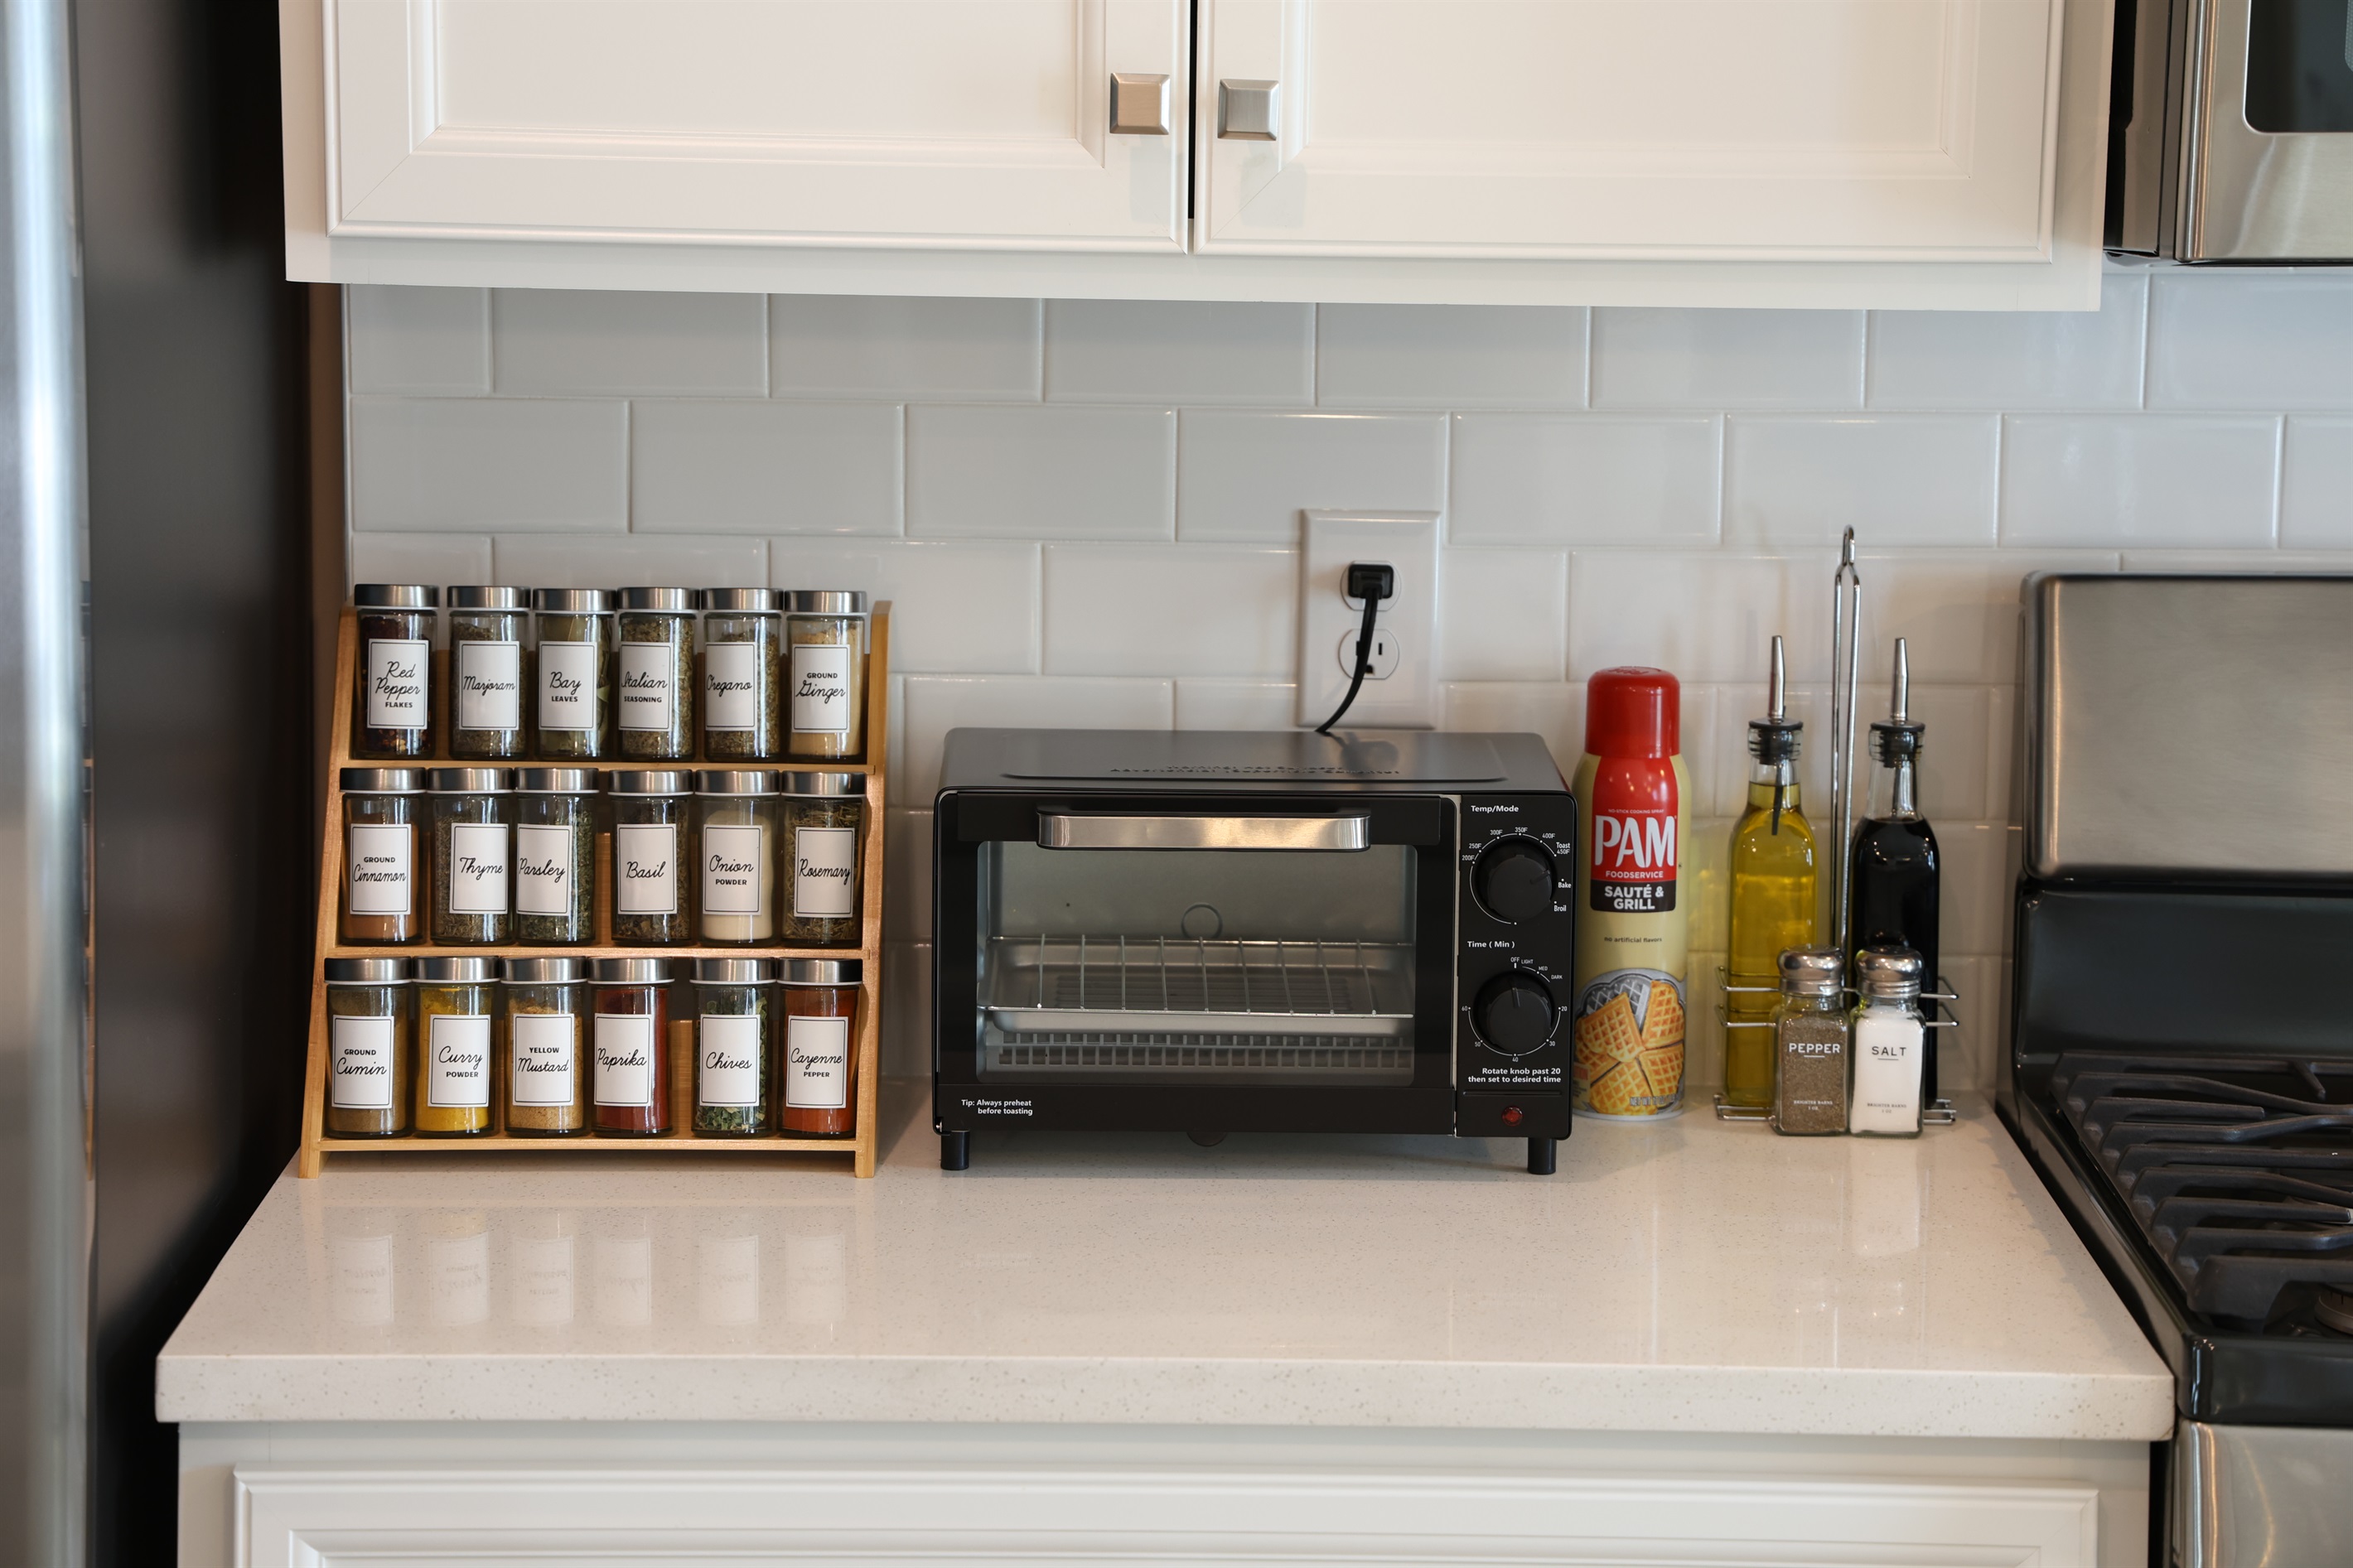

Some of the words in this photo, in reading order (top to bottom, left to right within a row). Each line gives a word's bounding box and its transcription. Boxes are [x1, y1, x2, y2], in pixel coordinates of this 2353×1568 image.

[386, 661, 416, 678] Red
[375, 677, 421, 701] Pepper
[463, 676, 515, 696] Marjoram
[549, 672, 582, 695] Bay
[621, 672, 668, 688] Italian
[707, 674, 752, 697] Oregano
[795, 680, 846, 703] Ginger
[1471, 805, 1520, 813] Temp/Mode
[1594, 815, 1675, 868] PAM
[460, 857, 504, 880] Thyme
[519, 857, 566, 883] Parsley
[626, 861, 666, 879] Basil
[709, 855, 754, 872] Onion
[799, 858, 850, 885] Rosemary
[354, 864, 406, 882] Cinnamon
[1606, 871, 1664, 879] FOODSERVICE
[1605, 884, 1652, 898] SAUTÉ
[1655, 886, 1664, 897] &
[1613, 898, 1655, 909] GRILL
[438, 1045, 483, 1069] Curry
[1789, 1043, 1840, 1054] PEPPER
[1872, 1046, 1906, 1056] SALT
[336, 1057, 387, 1075] Cumin
[517, 1058, 568, 1073] Mustard
[597, 1048, 647, 1072] Paprika
[706, 1052, 752, 1069] Chives
[790, 1047, 843, 1069] Cayenne
[961, 1099, 975, 1107] Tip:
[976, 1099, 1002, 1107] Always
[1003, 1099, 1032, 1107] preheat
[1003, 1107, 1033, 1116] toasting
